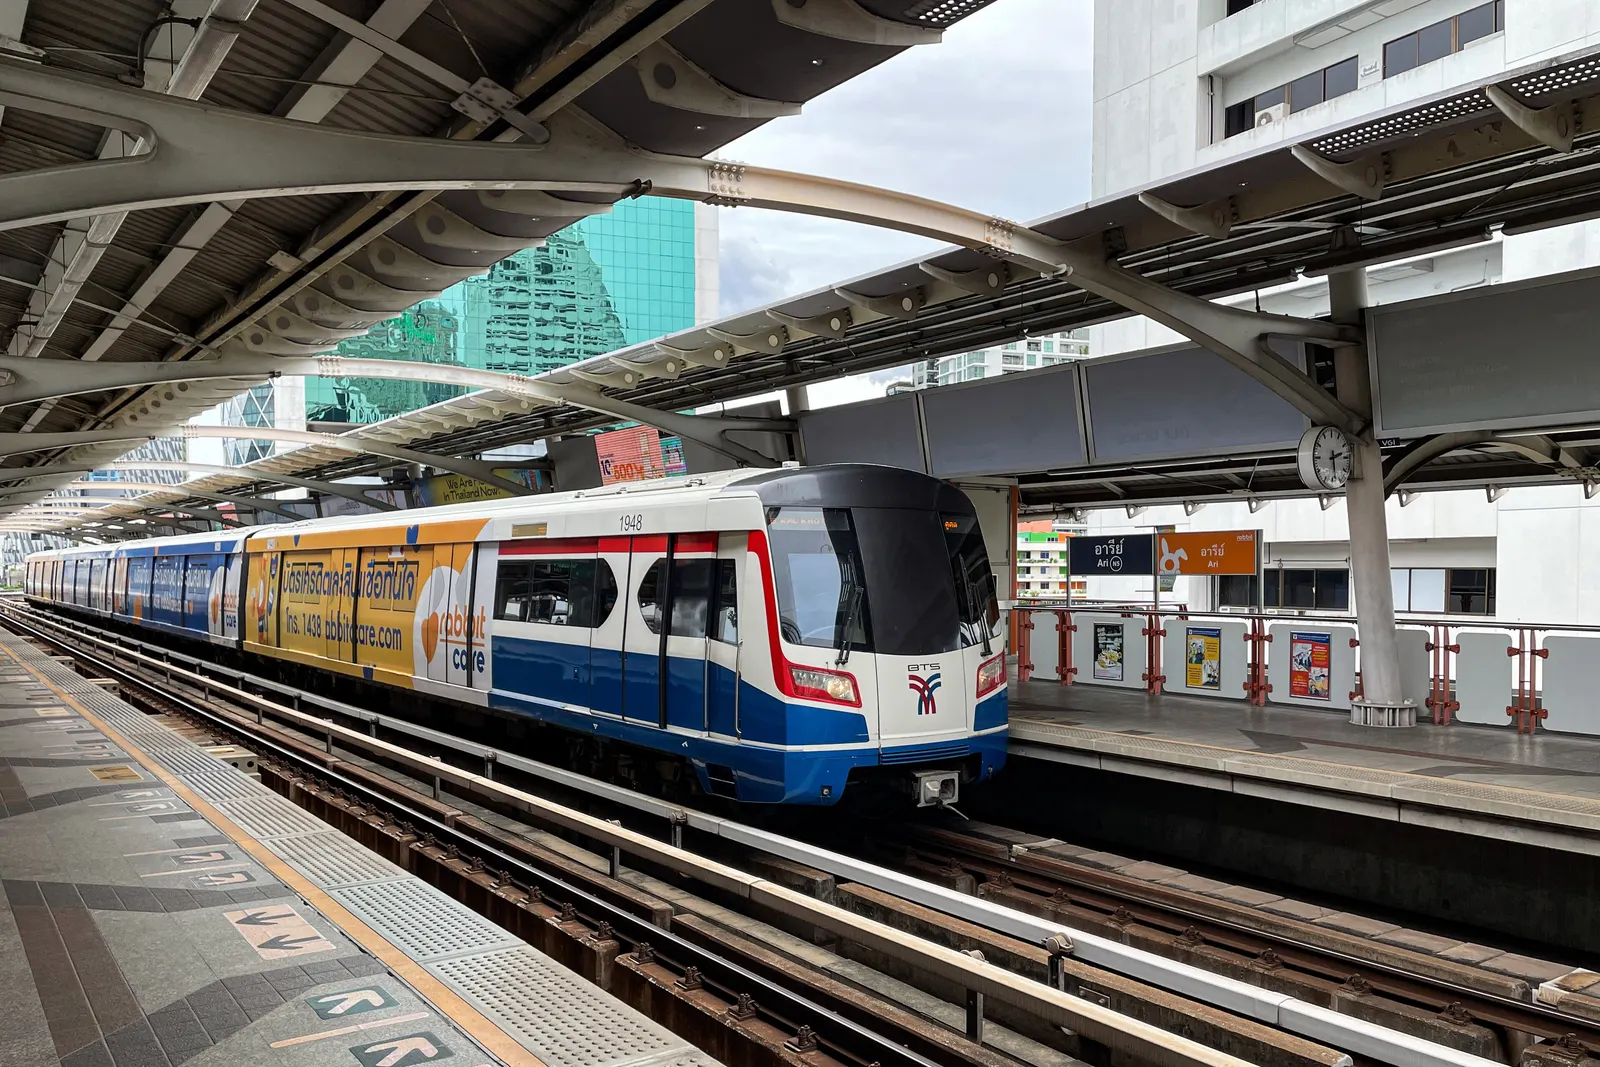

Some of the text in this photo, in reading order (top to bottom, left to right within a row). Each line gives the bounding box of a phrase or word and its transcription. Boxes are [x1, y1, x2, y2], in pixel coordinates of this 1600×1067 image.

[445, 479, 459, 490] We
[459, 477, 473, 489] Are
[442, 490, 450, 501] In
[450, 486, 480, 501] Thailand
[619, 514, 643, 532] 1948
[1094, 538, 1125, 555] อารีย์
[1200, 543, 1226, 557] อารีย์
[1097, 558, 1109, 568] Ari
[1207, 559, 1219, 568] Ari
[439, 603, 486, 640] rabbit
[303, 613, 322, 639] 1438
[325, 610, 402, 651] abbitcare.com
[453, 648, 485, 673] care
[907, 662, 941, 672] BTS
